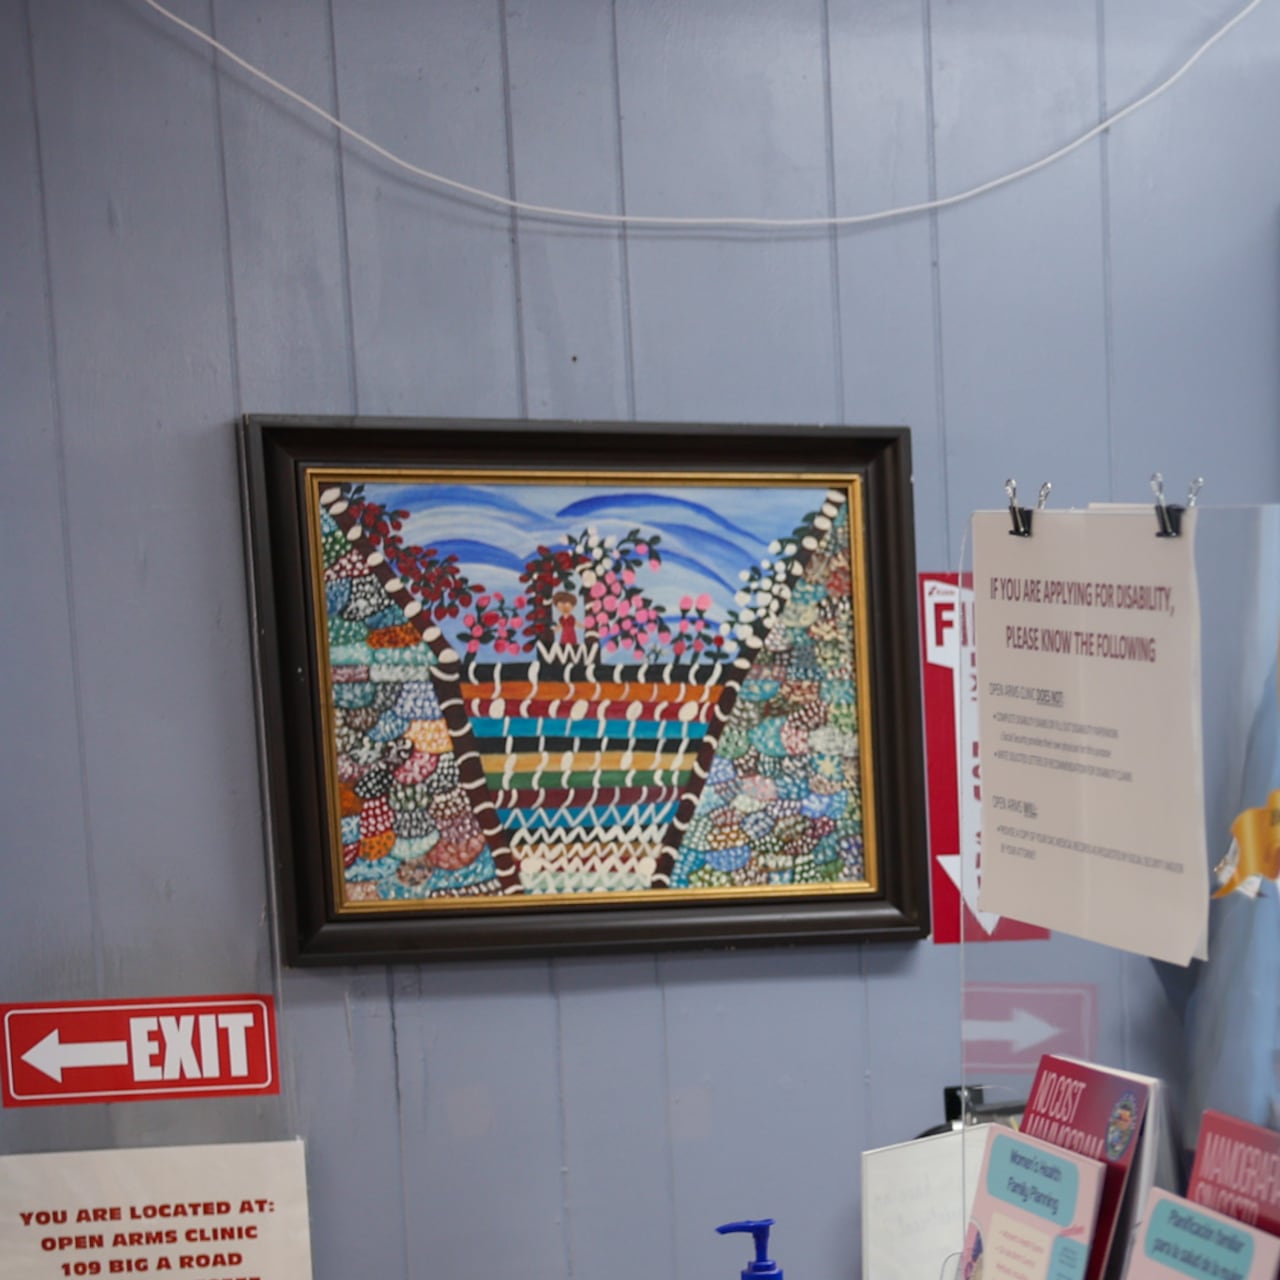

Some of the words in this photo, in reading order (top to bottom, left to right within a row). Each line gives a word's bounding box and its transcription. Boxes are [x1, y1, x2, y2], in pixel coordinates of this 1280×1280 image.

[990, 577, 999, 600] IF
[1000, 578, 1021, 602] YOU
[1023, 580, 1042, 604] ARE
[1043, 581, 1093, 607] APPLYING
[1095, 583, 1115, 609] FOR
[1116, 584, 1175, 616] DISABILITY,
[1006, 625, 1039, 651] PLEASE
[1041, 628, 1072, 655] KNOW
[1074, 631, 1094, 657] THE
[1097, 632, 1156, 663] FOLLOWING
[129, 1012, 254, 1082] EXIT
[1033, 1069, 1058, 1113] NO
[1051, 1074, 1087, 1124] COST
[19, 1210, 67, 1226] YOU
[76, 1207, 122, 1223] ARE
[130, 1201, 231, 1220] LOCATED
[239, 1199, 275, 1213] AT:
[41, 1234, 104, 1251] OPEN
[112, 1229, 177, 1247] ARMS
[185, 1225, 258, 1242] CLINIC
[61, 1262, 101, 1276] 109
[109, 1258, 148, 1273] BIG
[156, 1257, 172, 1270] A
[179, 1252, 243, 1269] ROAD
